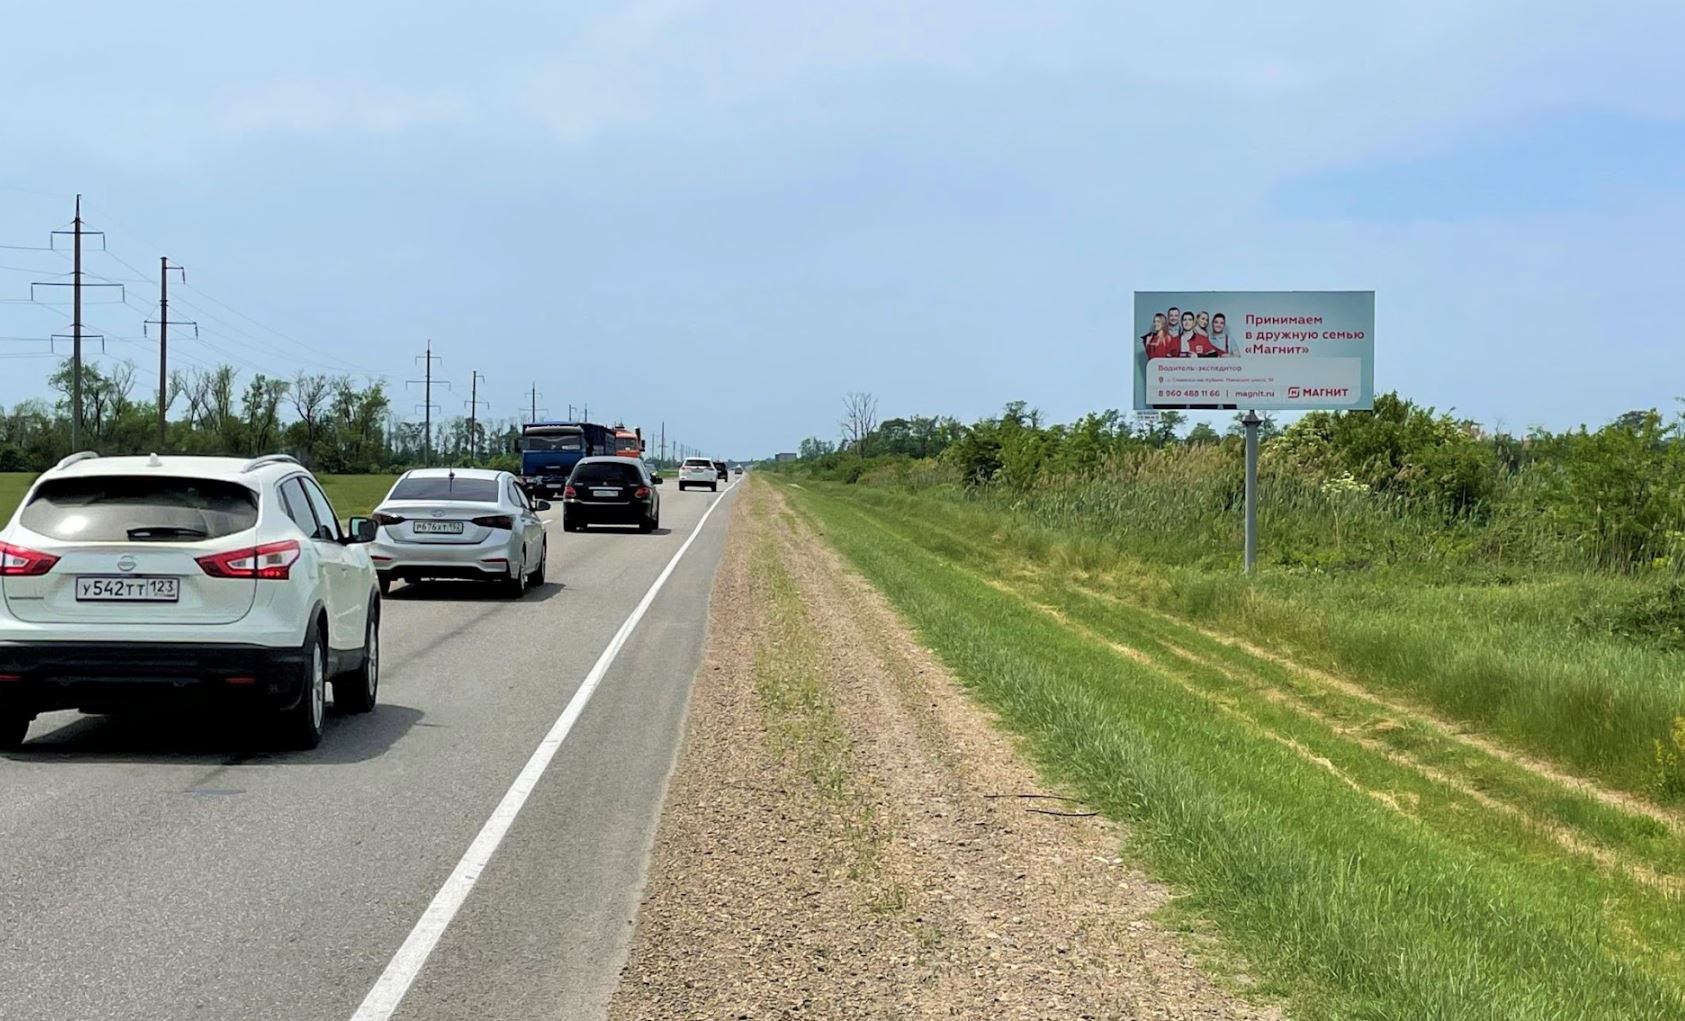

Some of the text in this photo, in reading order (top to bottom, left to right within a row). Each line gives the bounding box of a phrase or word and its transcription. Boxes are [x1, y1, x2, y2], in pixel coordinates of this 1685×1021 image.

[1245, 314, 1323, 326] Принимаем
[1245, 330, 1365, 342] в дружную семью
[1245, 344, 1309, 355] «Магнит»
[1235, 390, 1275, 399] magnit.ru
[1302, 388, 1349, 397] МАГНИТ
[150, 580, 174, 593] 123
